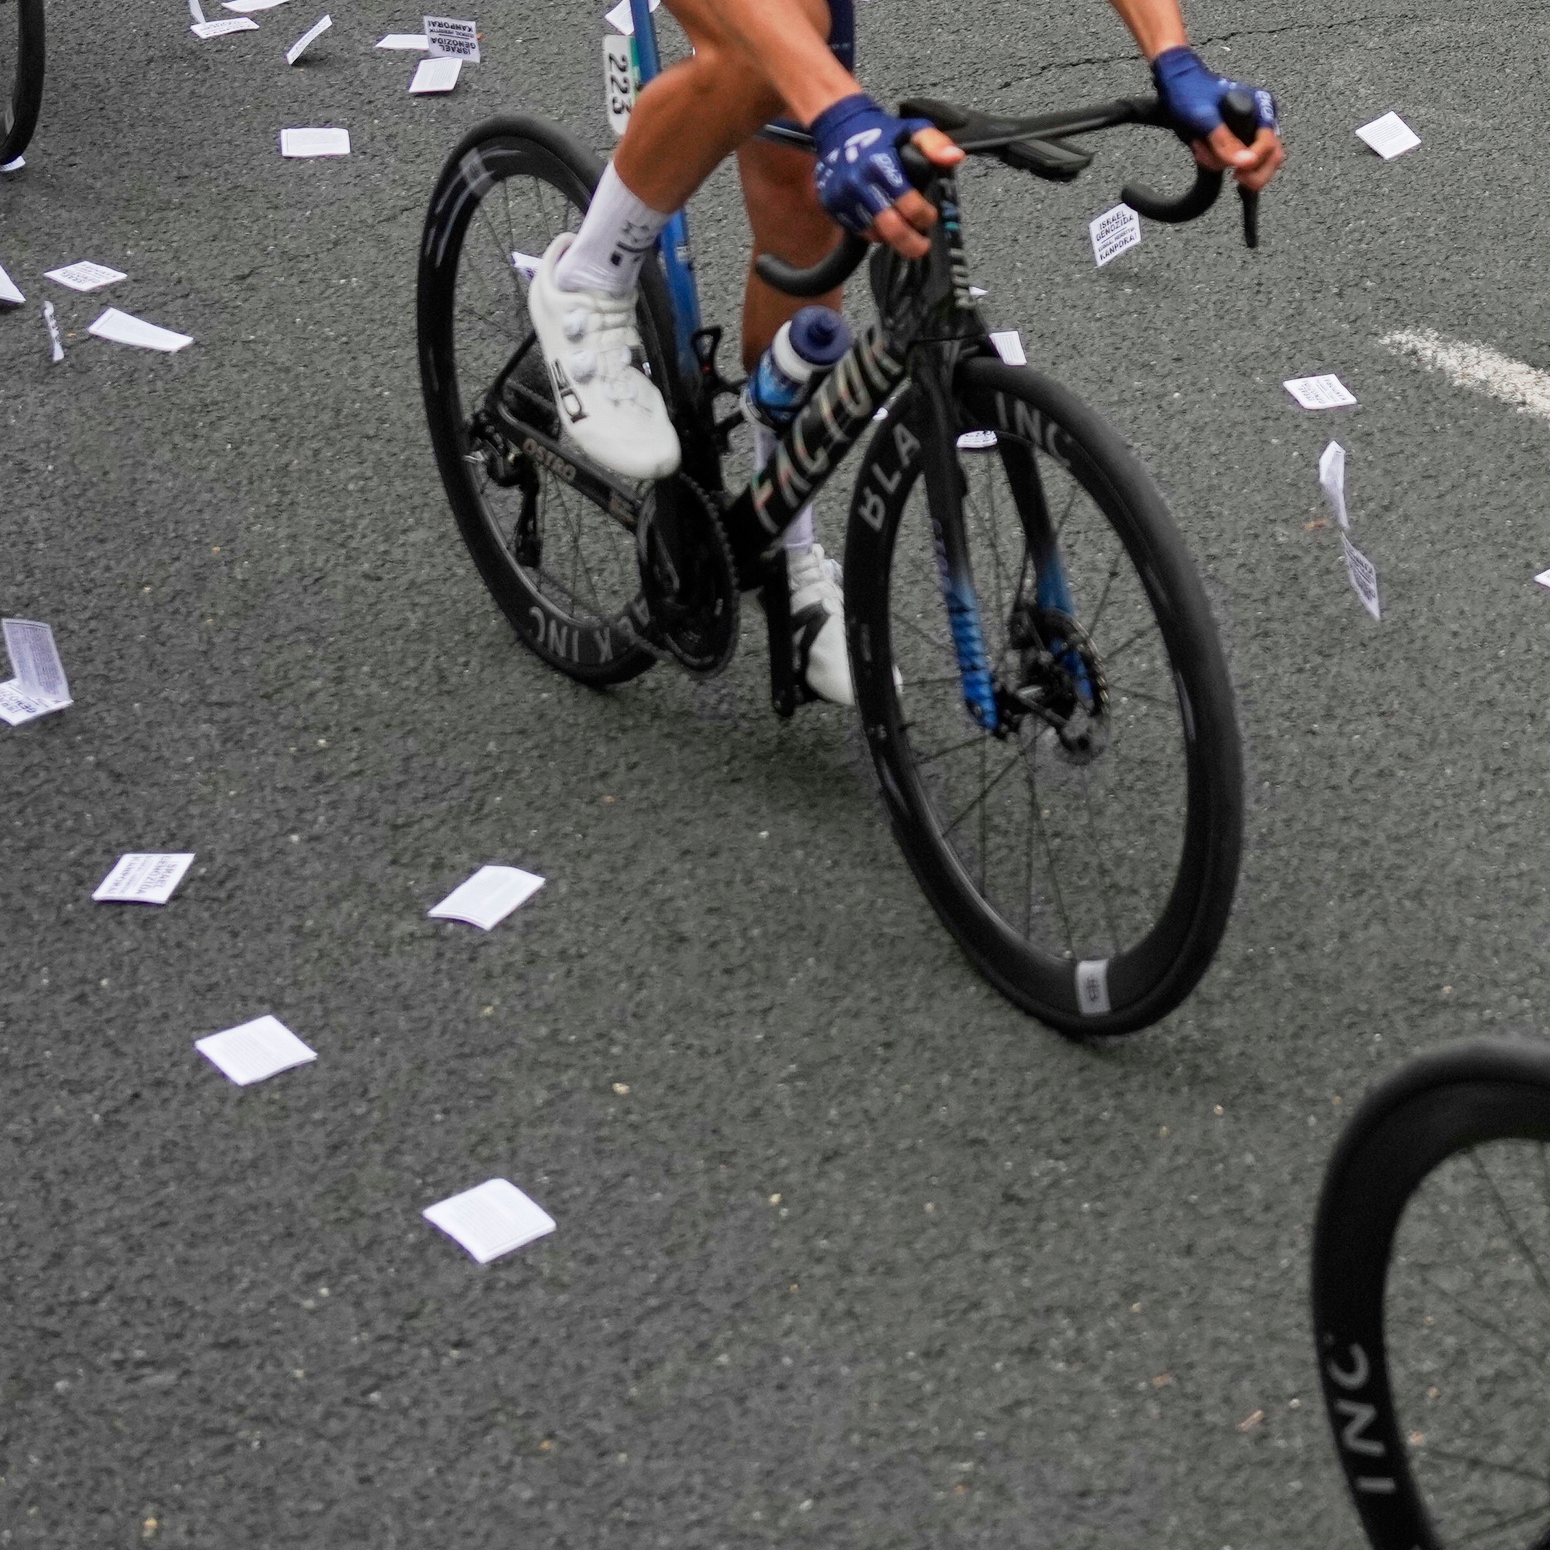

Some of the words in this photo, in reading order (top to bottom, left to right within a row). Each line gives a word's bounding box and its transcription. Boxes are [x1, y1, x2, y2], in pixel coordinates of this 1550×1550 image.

[427, 20, 474, 32] KANPORA!
[431, 37, 476, 50] GENOZIDA
[439, 44, 471, 55] ISRAEL
[609, 53, 632, 115] 223
[1096, 214, 1134, 241] GENOZIDA
[1100, 210, 1126, 230] ISRAEL
[1099, 233, 1137, 261] KANPORA!
[752, 322, 902, 536] FACTOR
[1328, 1343, 1396, 1494] INC
